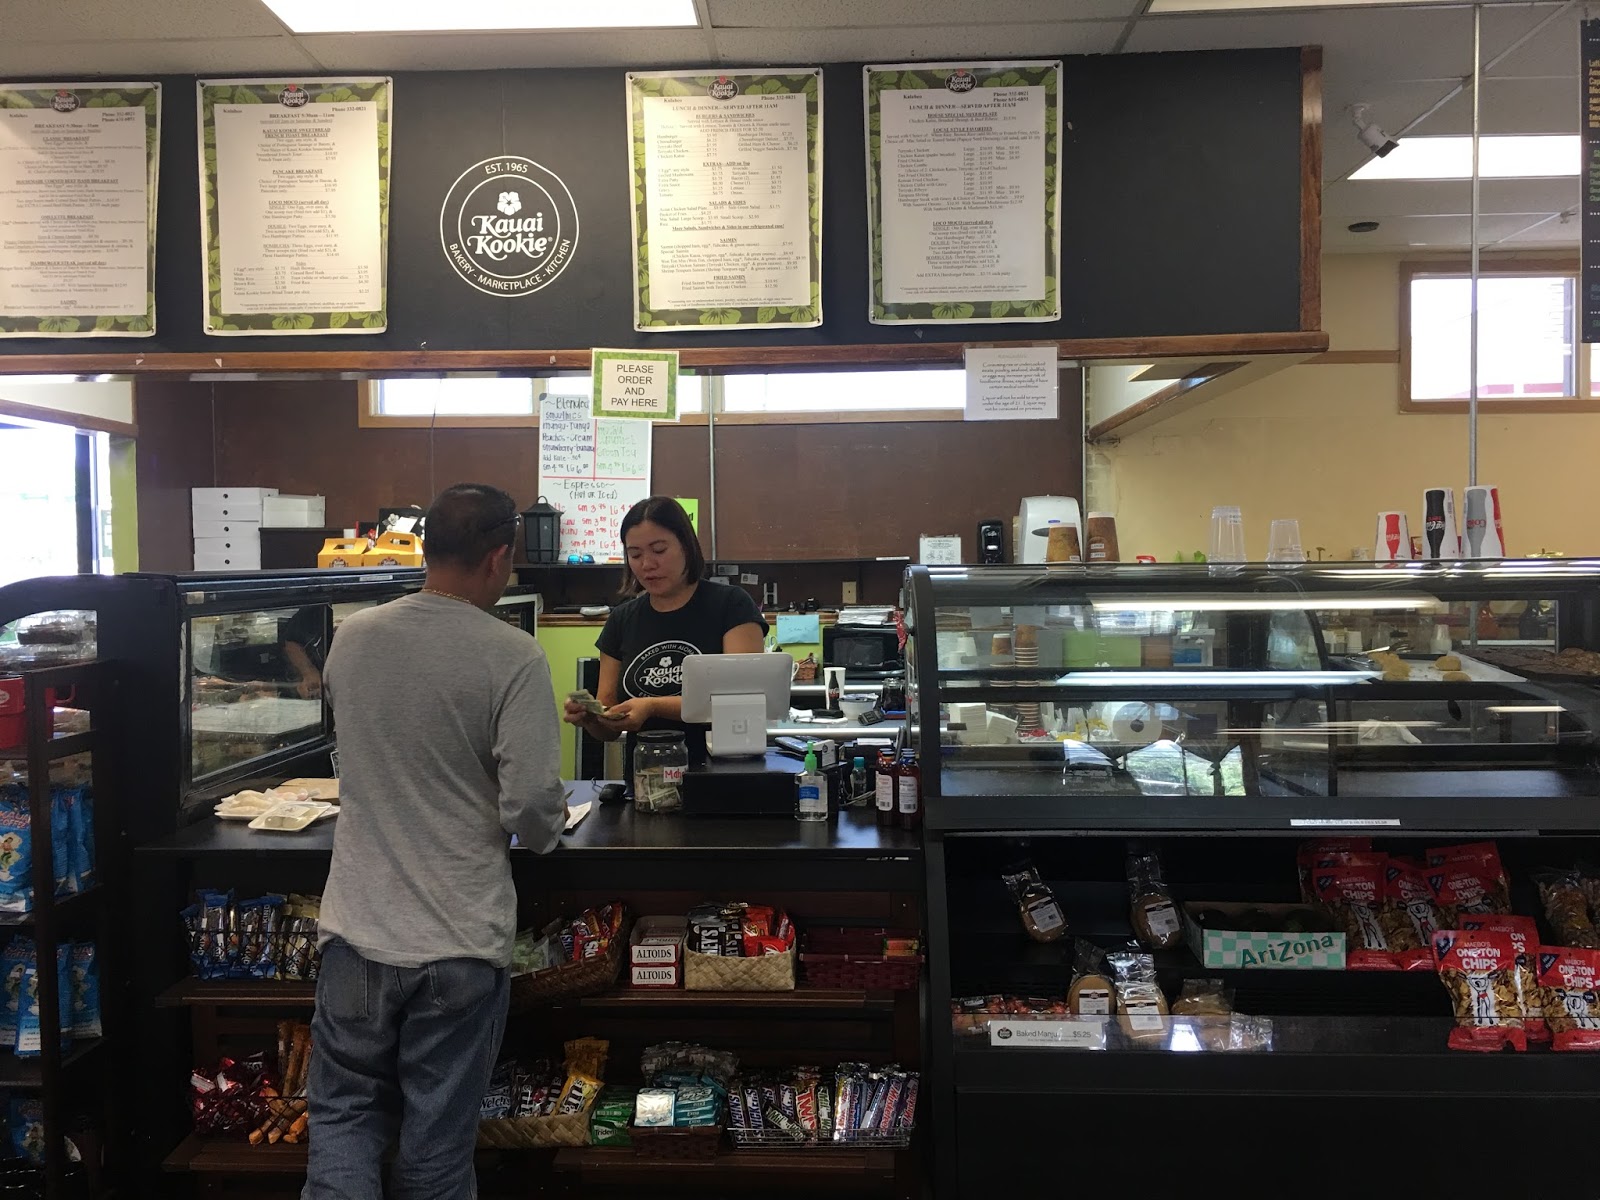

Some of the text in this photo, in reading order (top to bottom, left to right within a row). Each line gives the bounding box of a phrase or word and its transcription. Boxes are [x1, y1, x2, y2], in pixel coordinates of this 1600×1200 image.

[950, 82, 972, 91] Kookie
[712, 89, 735, 97] Kookie
[283, 97, 305, 105] Kookie
[484, 163, 528, 174] EST. 1965
[471, 212, 544, 238] Kauai
[467, 233, 548, 261] Kookie
[449, 239, 571, 290] BAKERY MARKETPLACE KITCHEN
[616, 364, 654, 374] PLEASE
[617, 376, 653, 385] ORDER
[624, 387, 645, 396] AND
[611, 398, 658, 407] PAY HERE
[564, 479, 606, 491] Espresso
[640, 647, 660, 660] BAKED
[1342, 889, 1375, 901] CHIPS
[1456, 887, 1486, 900] CHIPS
[636, 949, 672, 958] ALTOIDS
[1241, 935, 1334, 969] AriZona
[1462, 958, 1498, 970] CHIPS
[636, 970, 672, 980] ALTOIDS
[1558, 965, 1595, 976] ONE-TON
[1563, 975, 1593, 988] CHIPS
